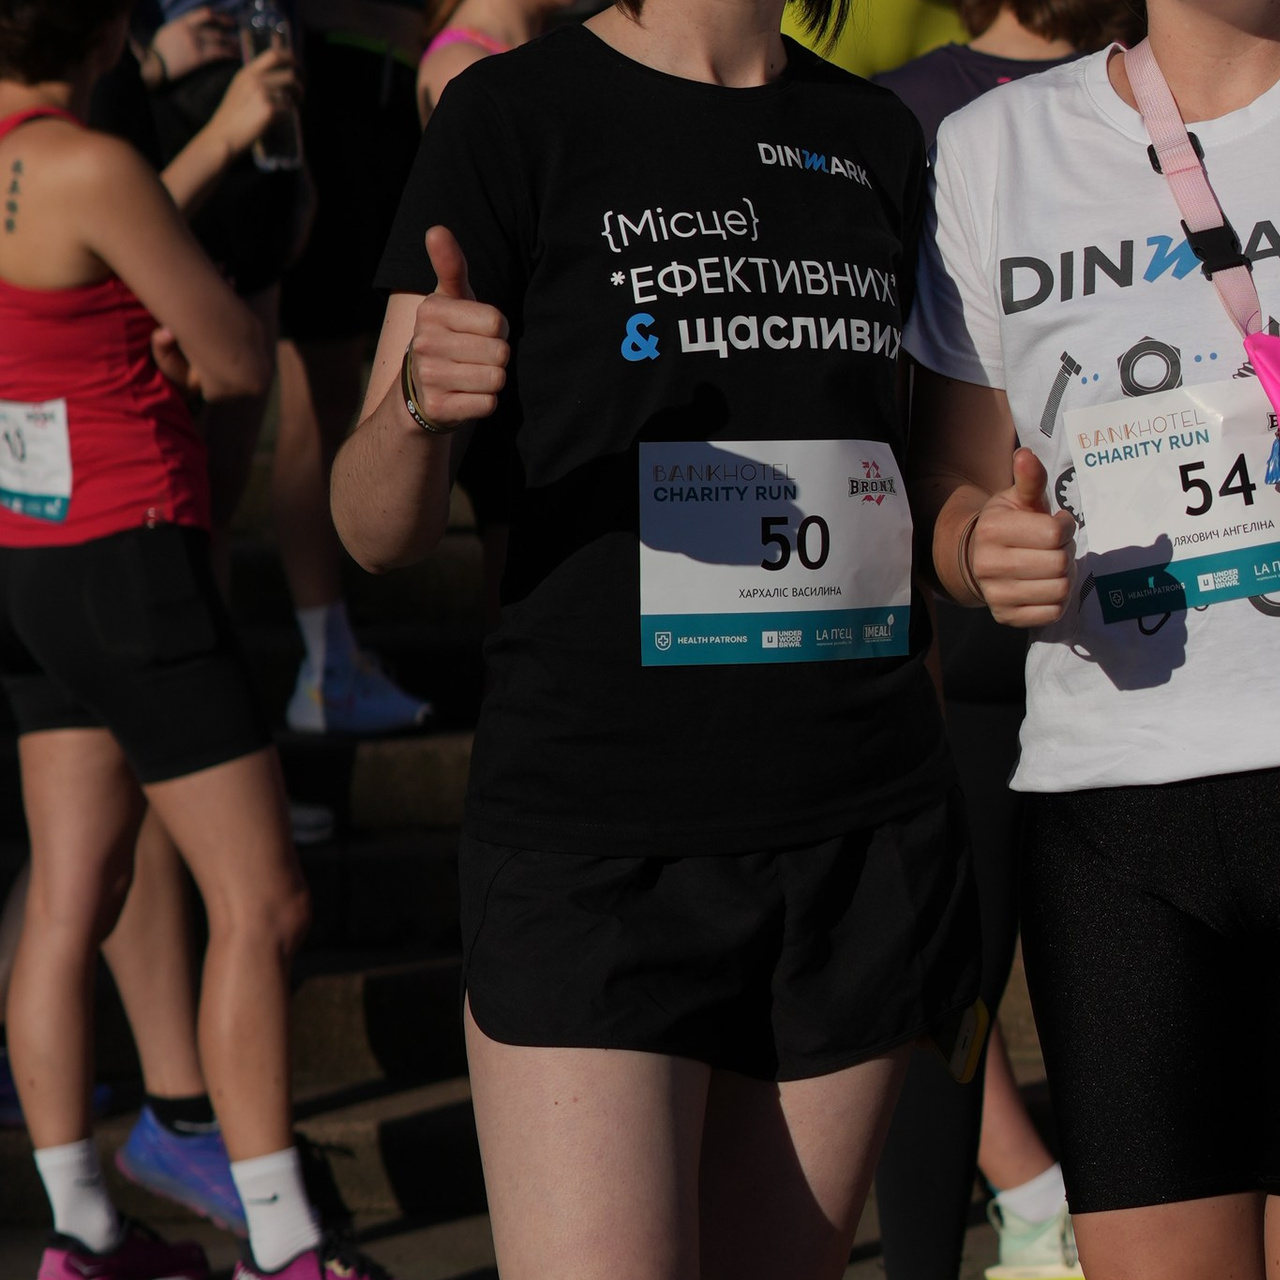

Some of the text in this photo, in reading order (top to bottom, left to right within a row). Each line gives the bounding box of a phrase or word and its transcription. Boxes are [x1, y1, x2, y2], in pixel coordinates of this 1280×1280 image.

[756, 142, 874, 190] DINMARK
[601, 197, 760, 254] {Місце}
[620, 311, 661, 363] &
[1076, 408, 1206, 450] BANKHOTEL
[1083, 429, 1210, 468] CHARITY RUN
[652, 463, 796, 483] BANKHOTEL
[1178, 452, 1257, 516] 54
[653, 485, 797, 502] CHARITY RUN
[849, 477, 897, 497] BRONX
[761, 515, 830, 571] 50
[1173, 520, 1275, 548] ЛЯХОВИЧ АНГЕЛІНА
[1213, 568, 1238, 578] UNDER
[1214, 574, 1239, 584] WOOD
[1254, 563, 1271, 576] LA
[738, 586, 842, 599] ХАРХАЛІС ВАСИЛИНА
[677, 635, 748, 645] HEALTH PATRONS
